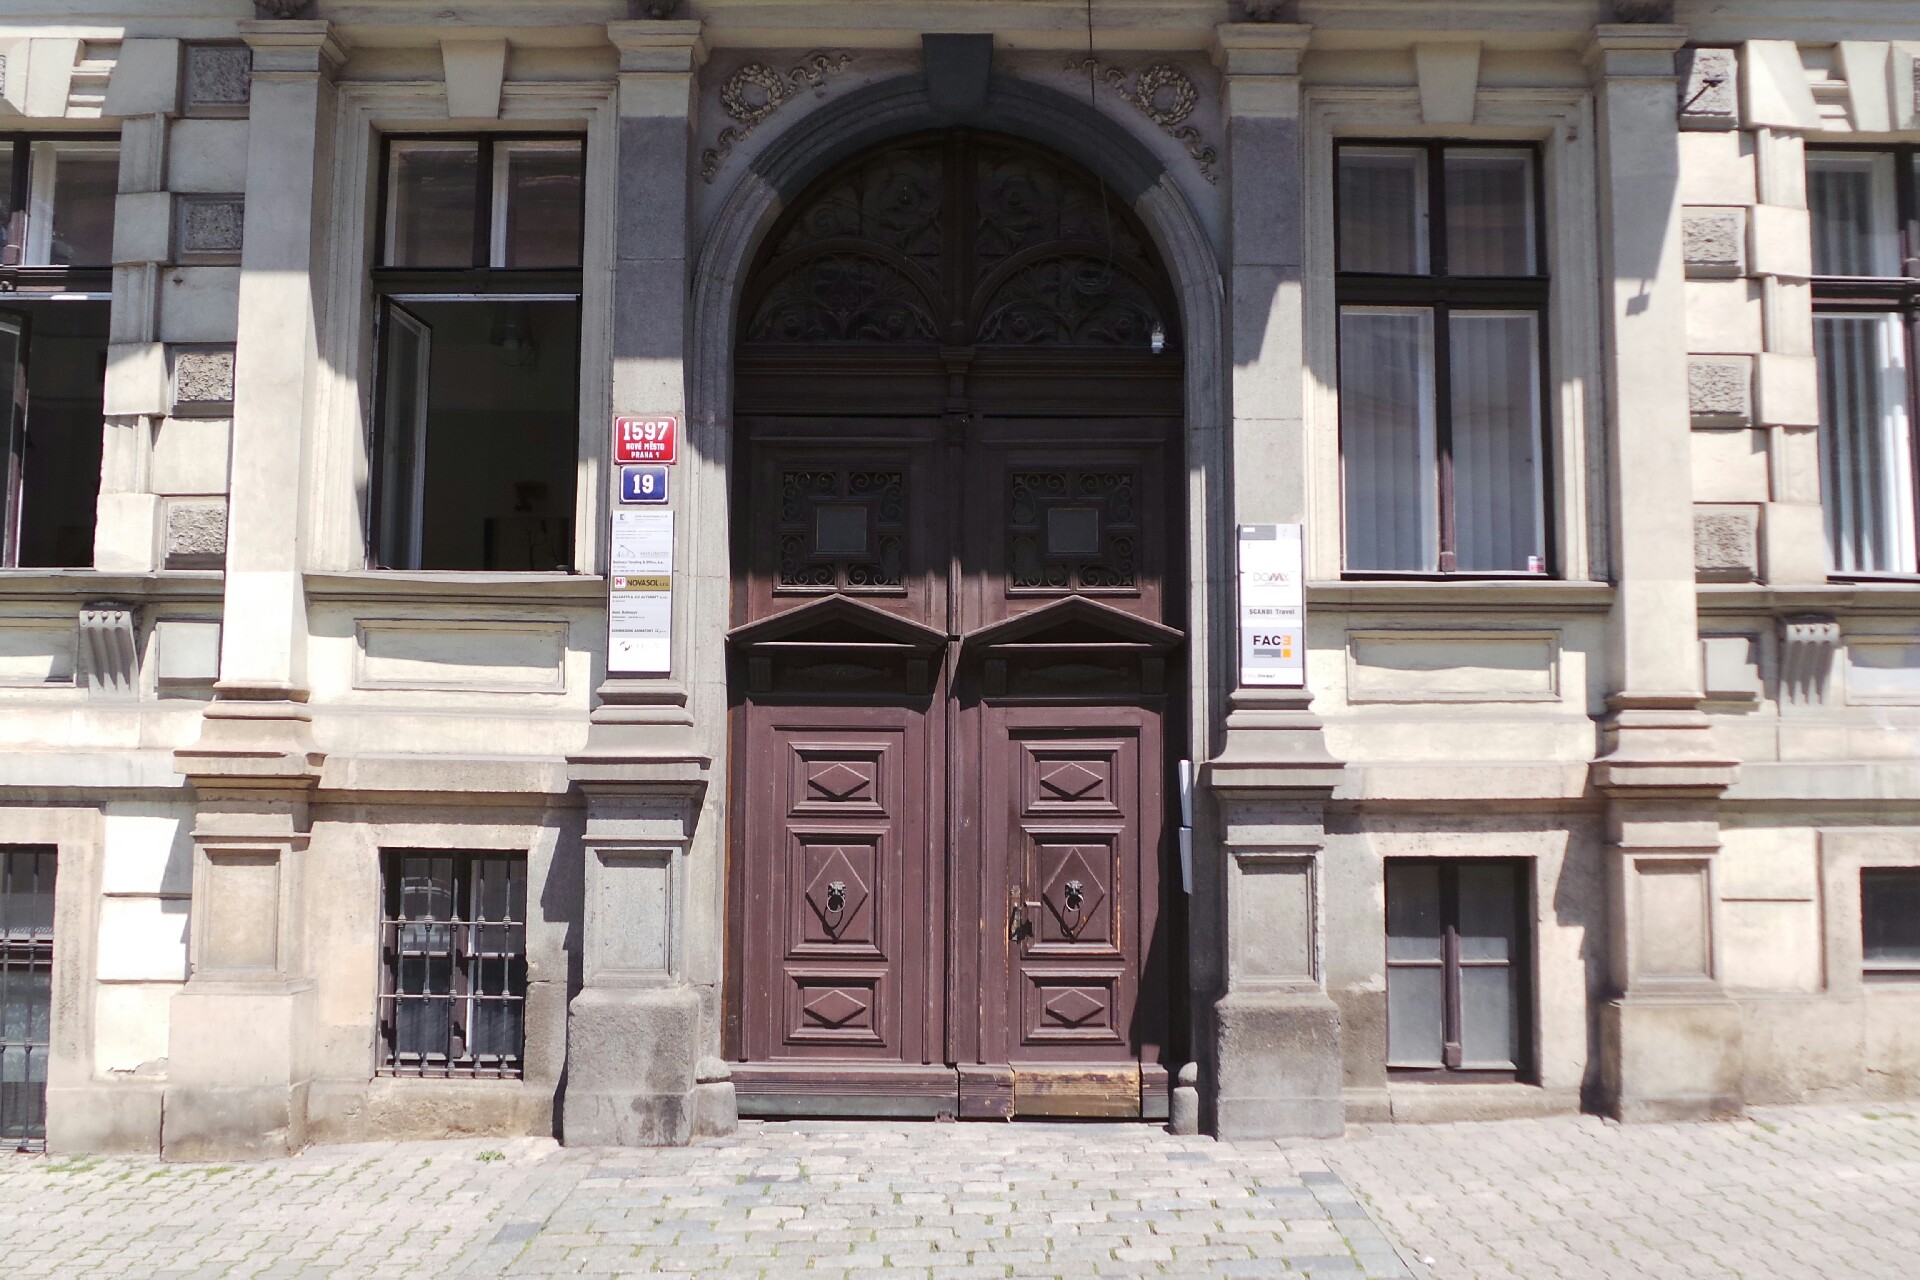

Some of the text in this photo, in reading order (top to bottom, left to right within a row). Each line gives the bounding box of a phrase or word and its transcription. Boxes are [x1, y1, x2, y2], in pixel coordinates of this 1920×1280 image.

[623, 421, 668, 440] 1597
[626, 441, 665, 451] NOVÉ MĚSTO
[633, 474, 654, 494] 19
